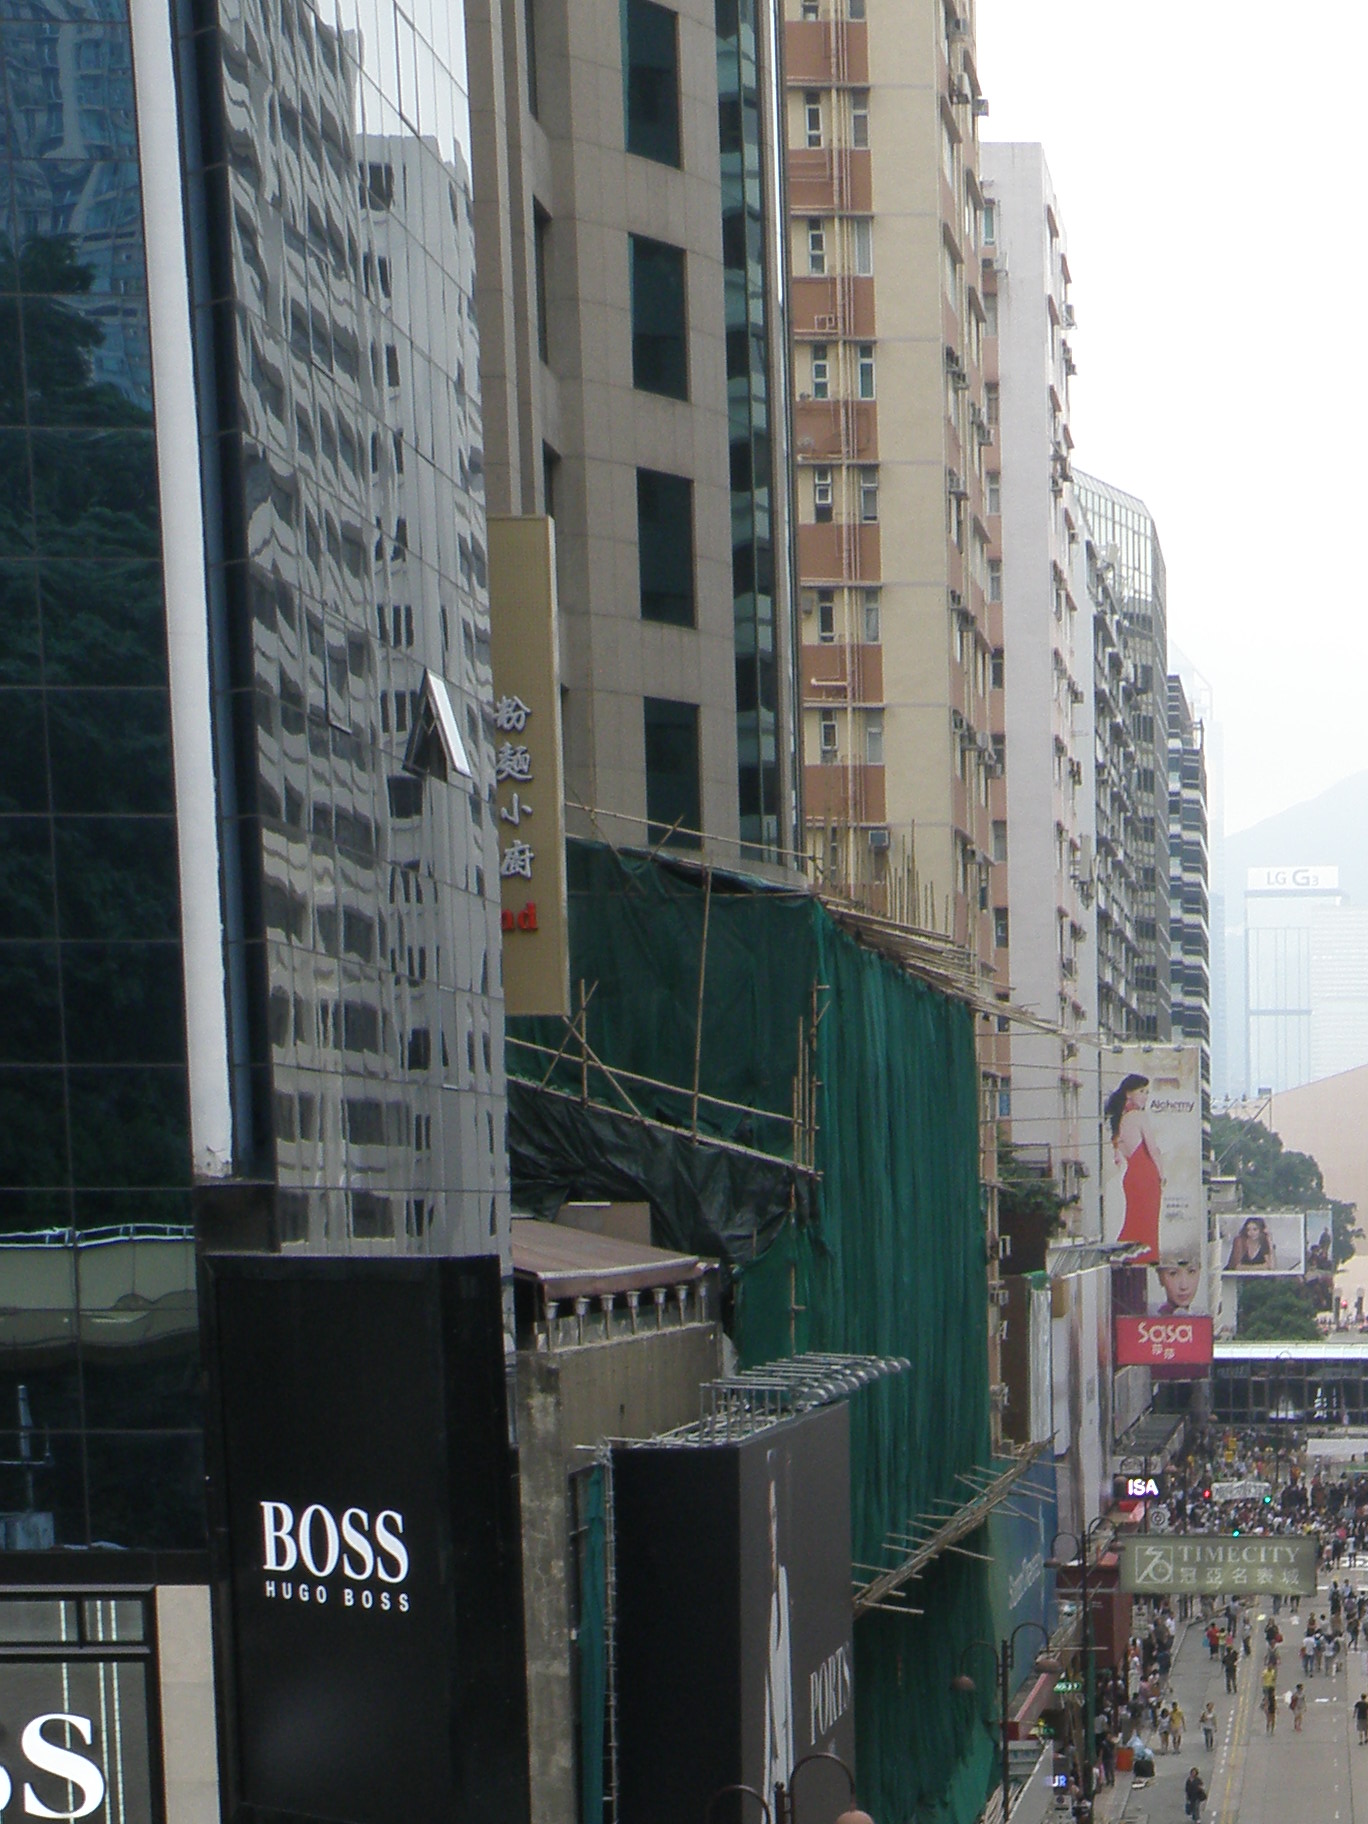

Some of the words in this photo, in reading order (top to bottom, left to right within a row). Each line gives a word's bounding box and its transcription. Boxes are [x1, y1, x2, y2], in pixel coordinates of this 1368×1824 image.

[1266, 871, 1287, 886] LG
[1150, 1100, 1195, 1112] Alchemy
[1128, 1478, 1160, 1496] ISA
[260, 1501, 410, 1584] BOSS
[1178, 1546, 1299, 1563] TIMECITY
[266, 1581, 327, 1604] HUGO
[344, 1589, 410, 1613] BOSS
